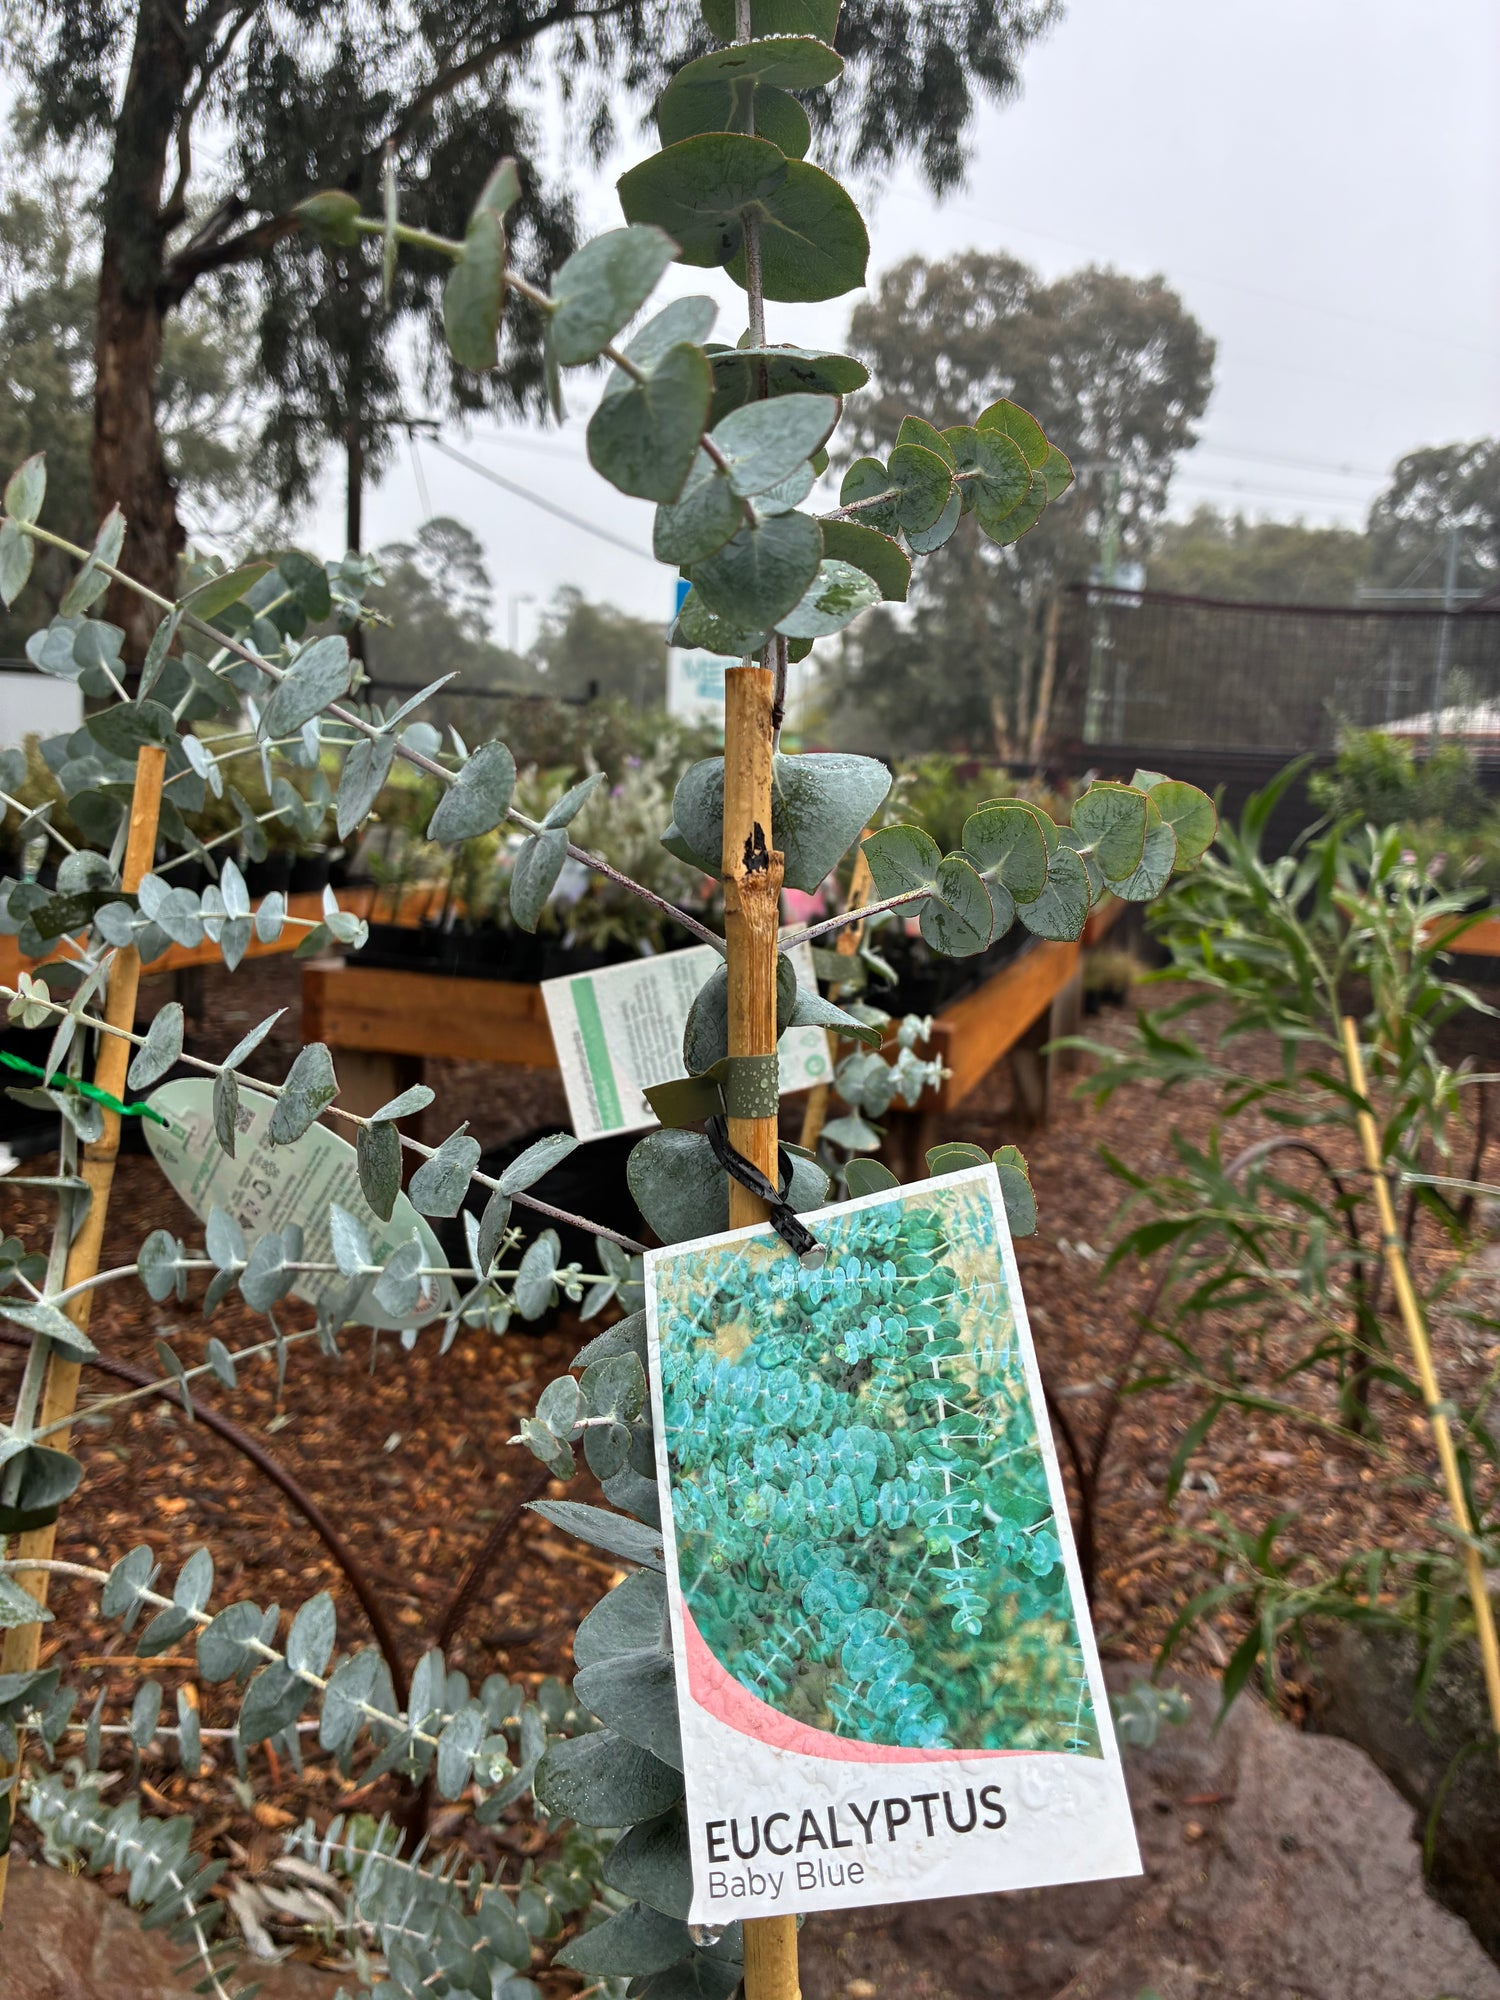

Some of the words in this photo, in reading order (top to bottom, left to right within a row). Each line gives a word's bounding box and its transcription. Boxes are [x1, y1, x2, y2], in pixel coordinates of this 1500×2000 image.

[706, 1785, 1008, 1863] EUCALYPTUS
[709, 1867, 785, 1900] Baby
[796, 1858, 865, 1890] Blue
